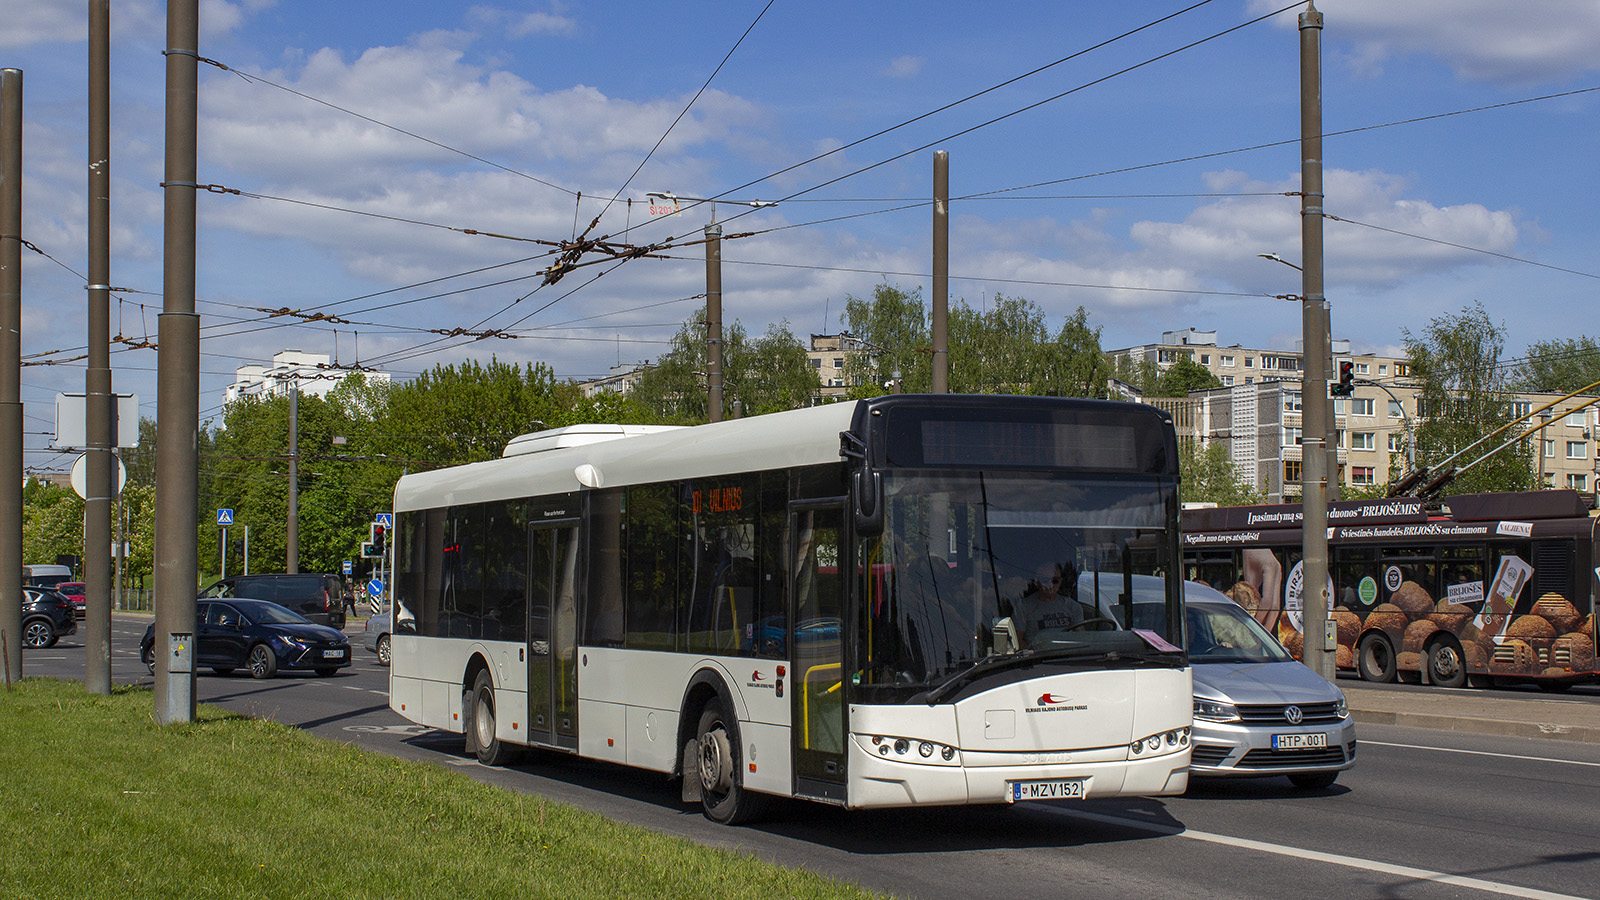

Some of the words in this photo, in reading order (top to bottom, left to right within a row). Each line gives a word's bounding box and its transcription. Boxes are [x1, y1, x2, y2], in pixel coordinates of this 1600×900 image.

[709, 486, 742, 512] VILNIUS
[1362, 502, 1421, 518] BRIJOŠĖMIS!
[1251, 511, 1294, 524] pasimatymą
[1450, 526, 1487, 535] cinamonu
[1044, 617, 1070, 628] RULES
